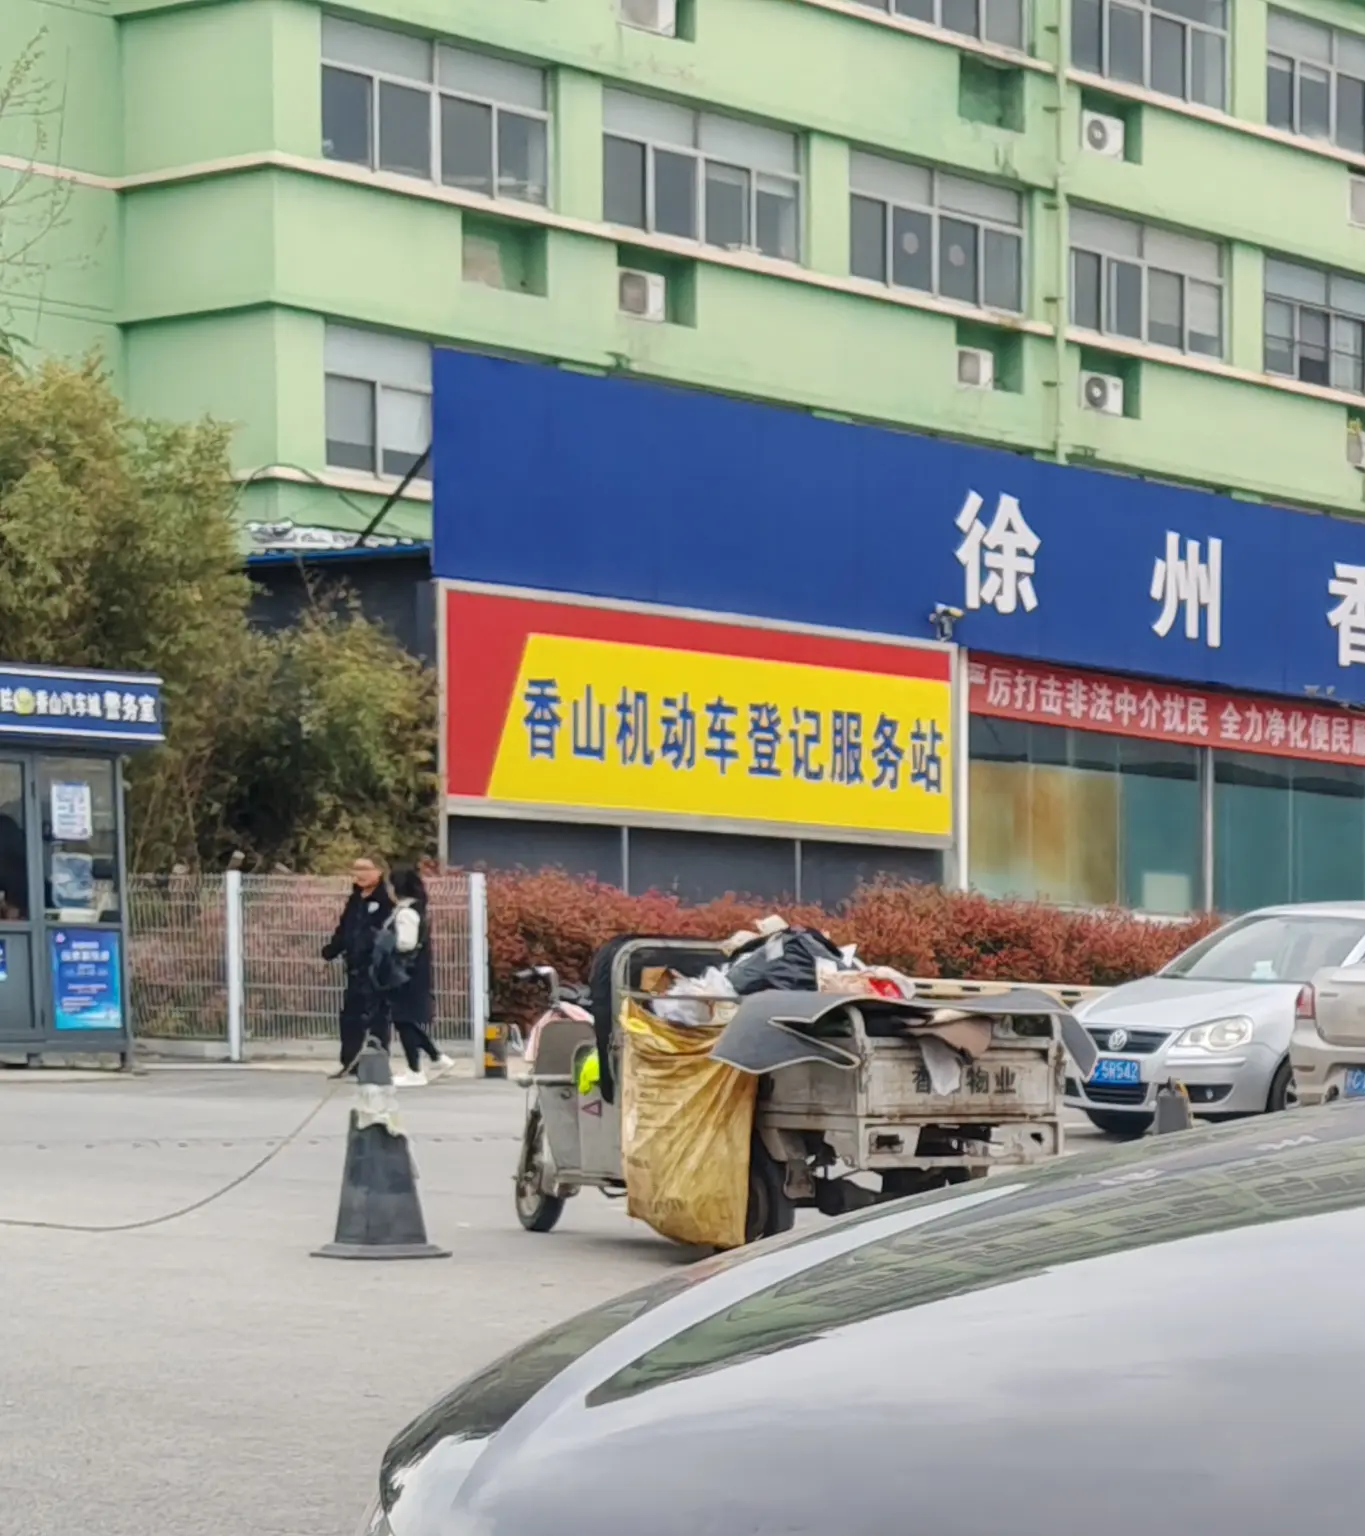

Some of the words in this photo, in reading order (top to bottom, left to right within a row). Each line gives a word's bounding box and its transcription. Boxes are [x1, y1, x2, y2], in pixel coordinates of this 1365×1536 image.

[522, 677, 945, 794] 香山机动车登记服务站
[911, 1065, 1017, 1096] 香物业
